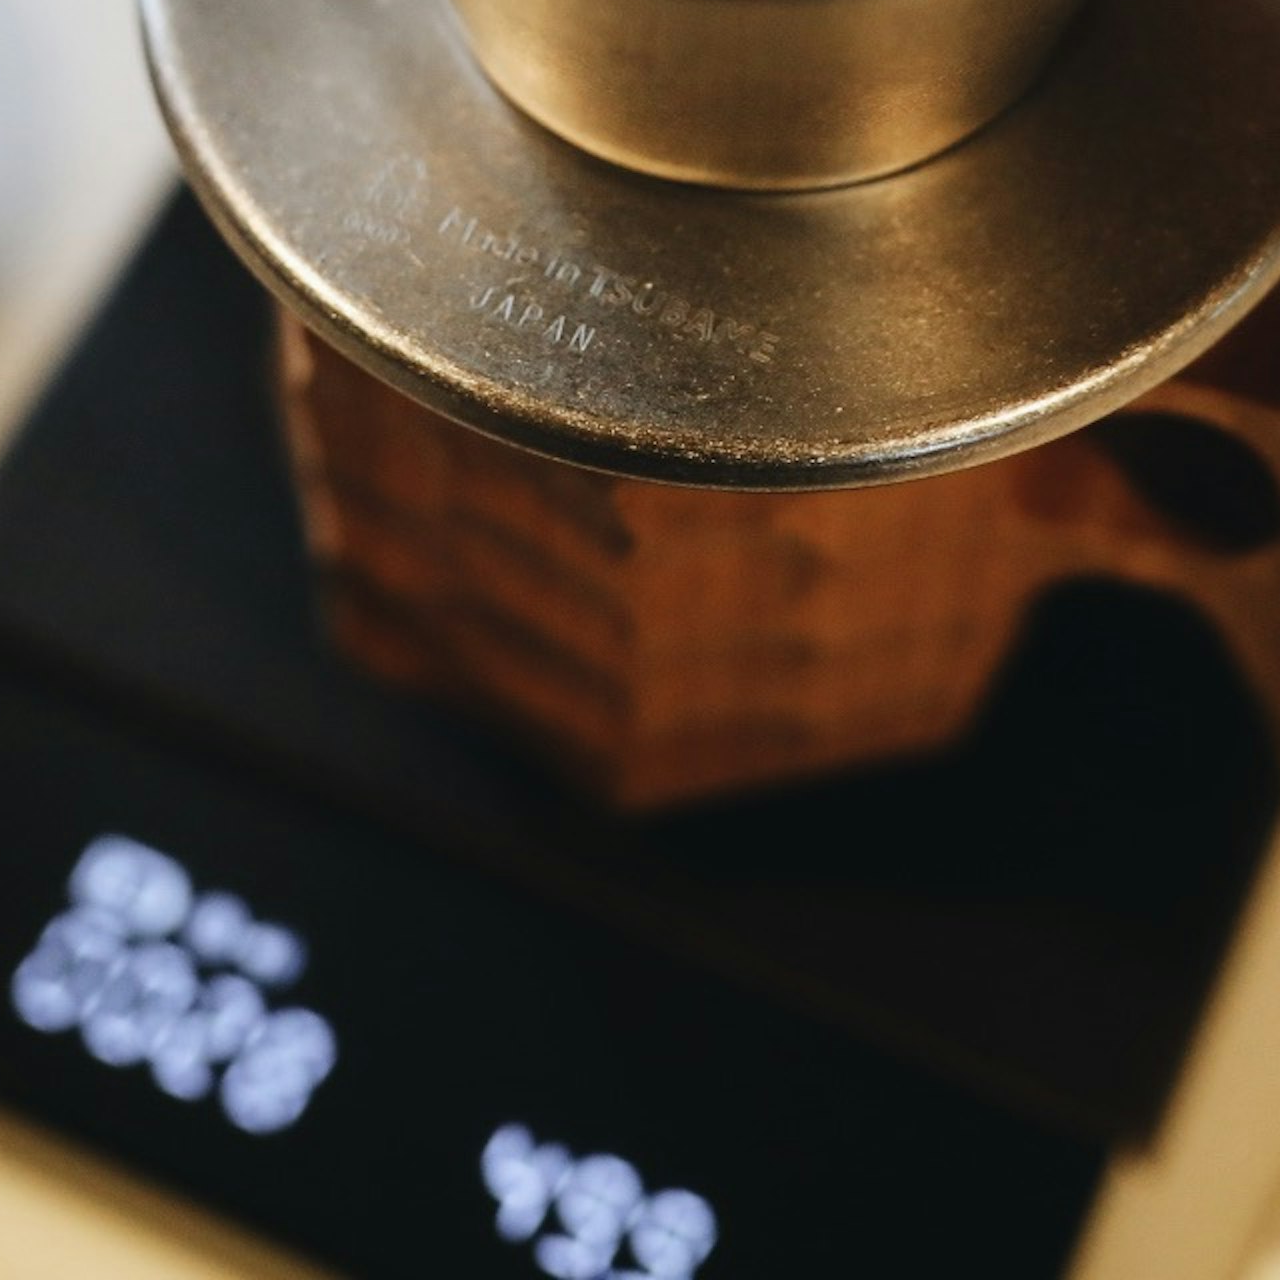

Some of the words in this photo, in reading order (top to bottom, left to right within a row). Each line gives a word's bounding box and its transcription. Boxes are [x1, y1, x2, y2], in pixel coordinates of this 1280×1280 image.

[437, 205, 538, 265] Made
[588, 263, 781, 364] TSUBAME
[469, 286, 596, 353] JAPAN
